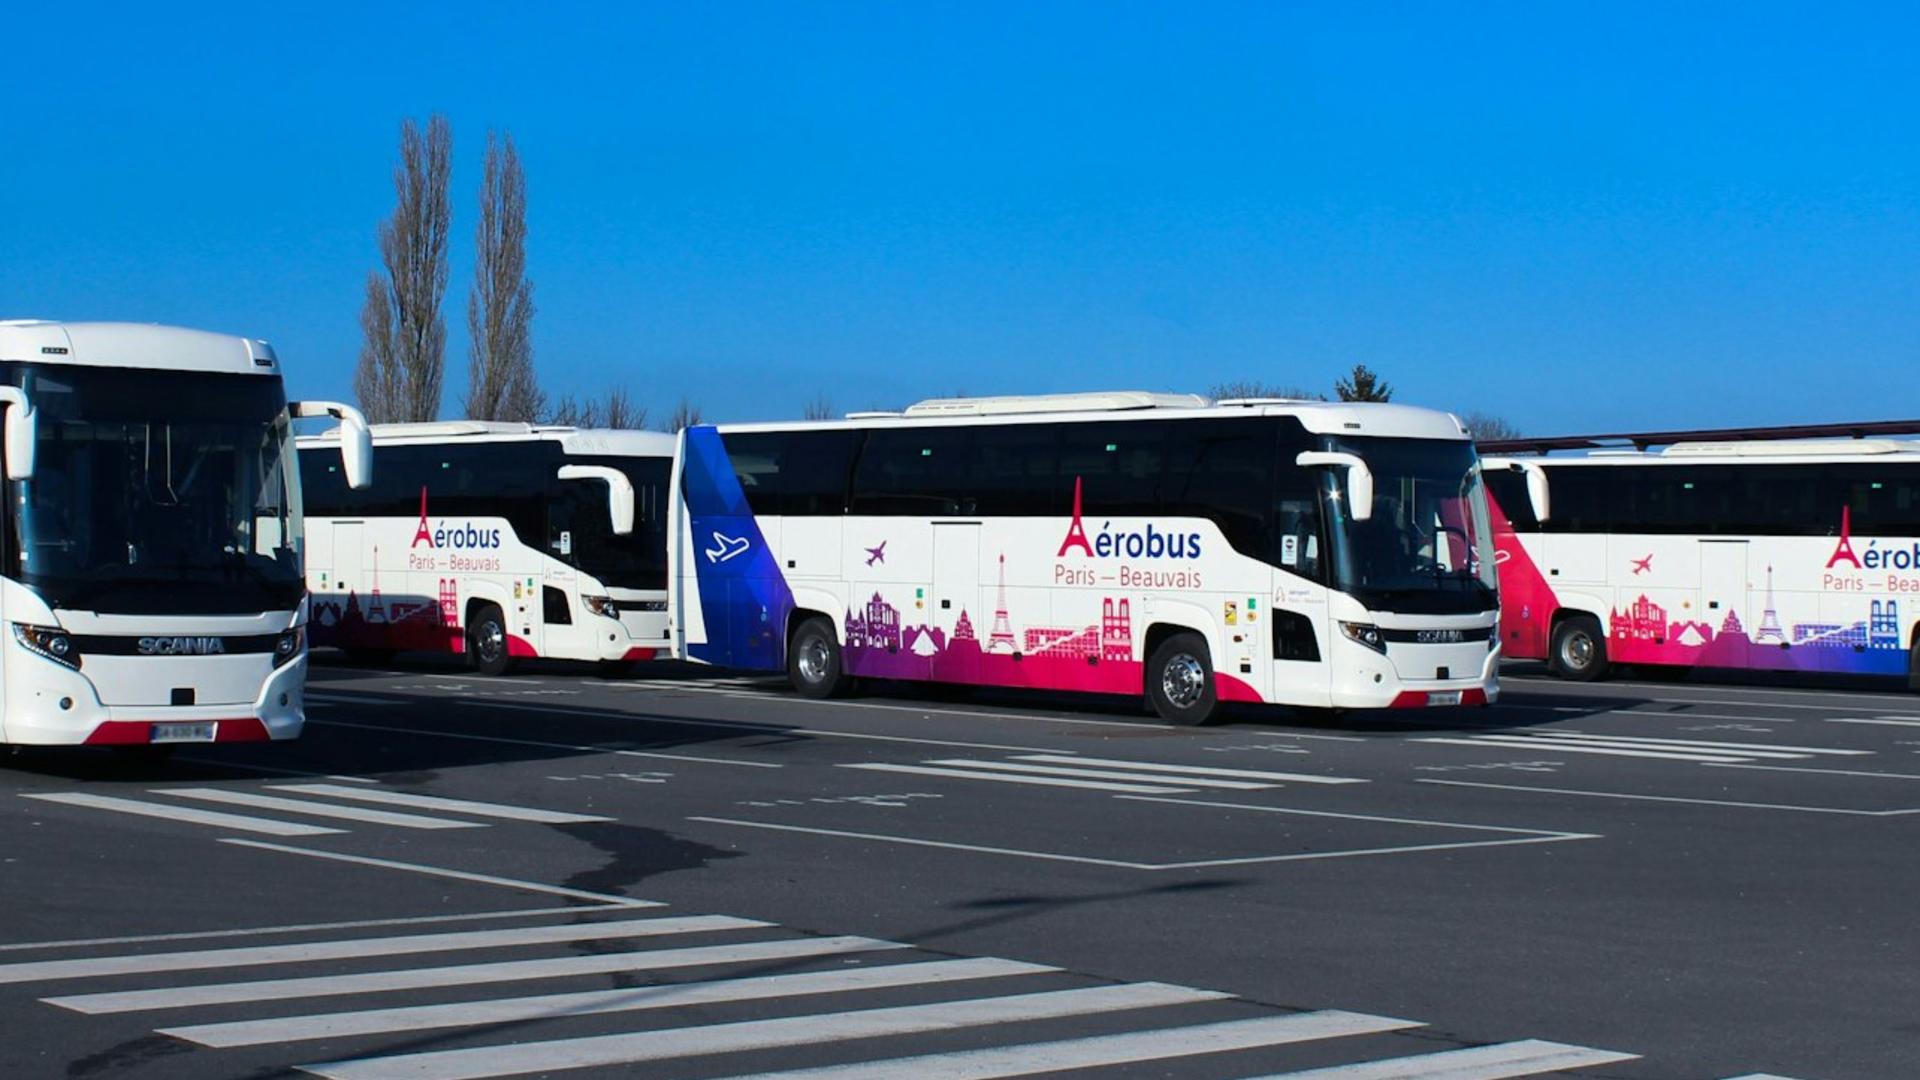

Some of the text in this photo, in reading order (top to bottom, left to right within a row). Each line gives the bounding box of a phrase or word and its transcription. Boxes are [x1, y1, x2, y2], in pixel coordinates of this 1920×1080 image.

[411, 486, 500, 549] Aérobus
[1057, 475, 1201, 559] Aérobus
[409, 553, 435, 570] Paris
[449, 554, 500, 571] Beauvais
[1055, 564, 1095, 585] Paris
[1120, 565, 1202, 588] Beauvais
[1823, 574, 1864, 591] Paris
[137, 637, 225, 655] SCANIA
